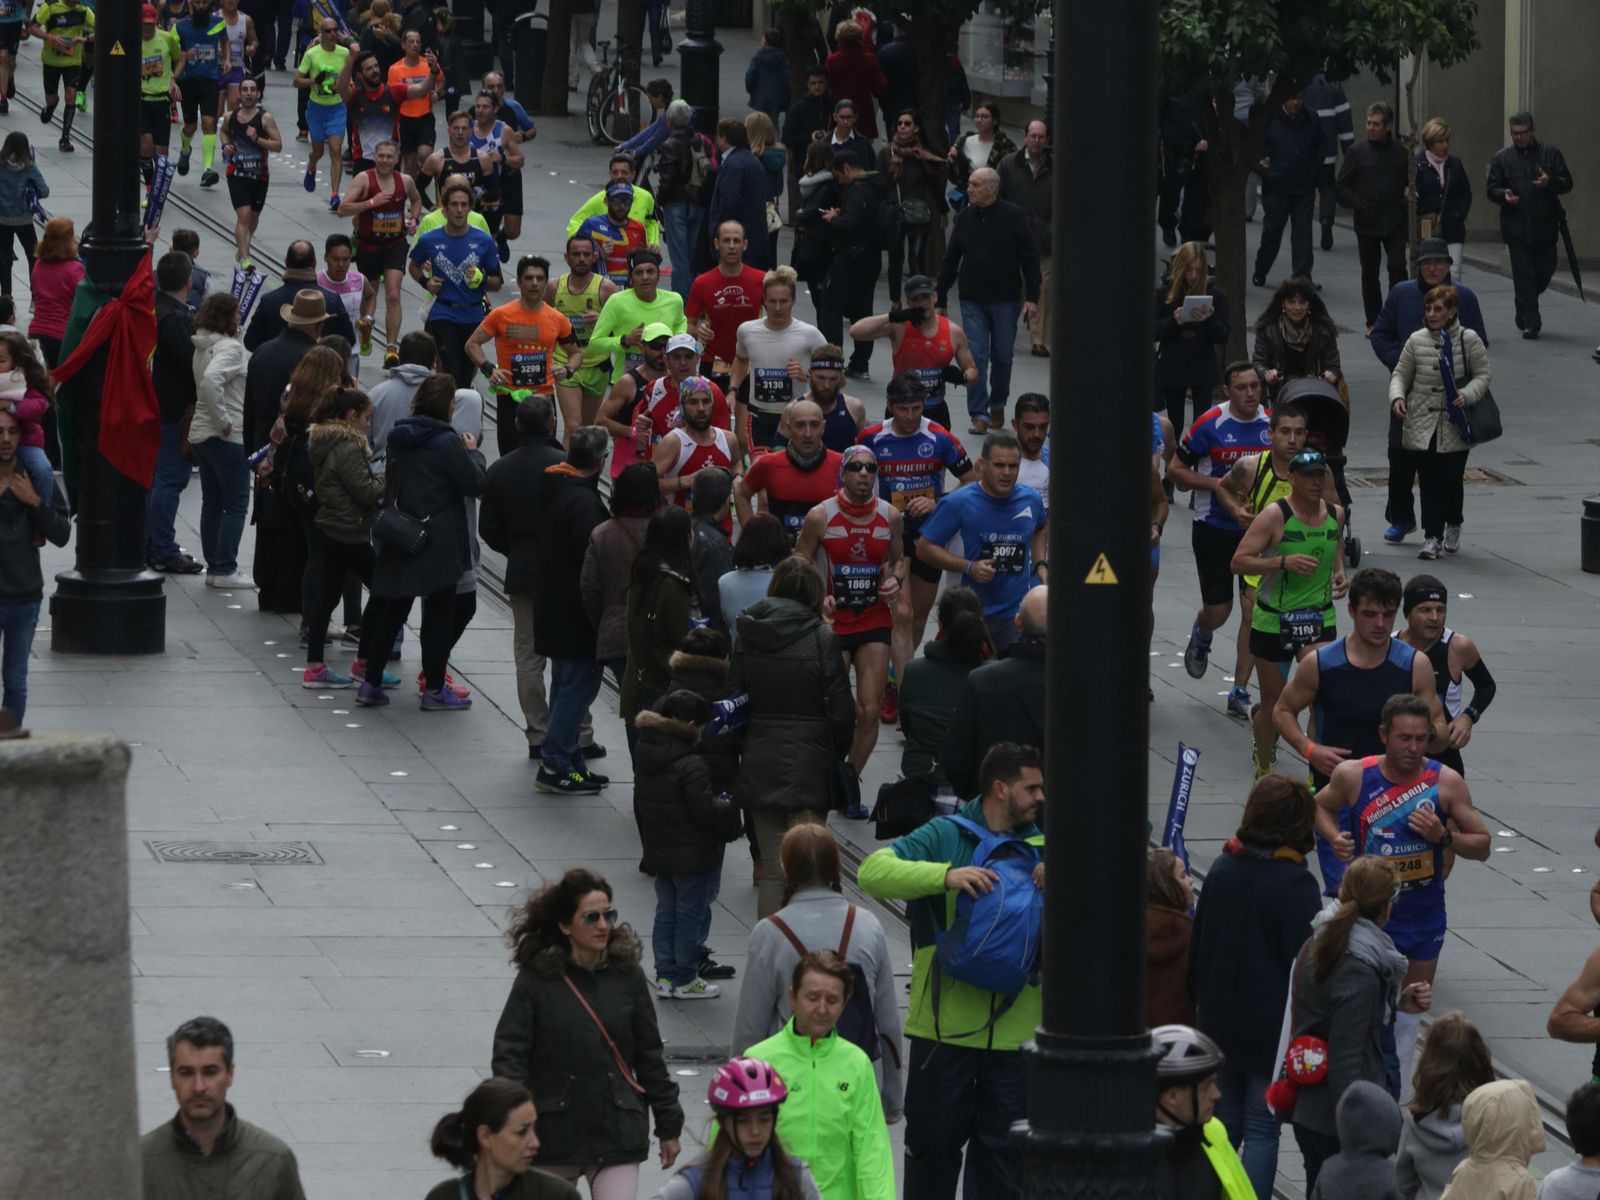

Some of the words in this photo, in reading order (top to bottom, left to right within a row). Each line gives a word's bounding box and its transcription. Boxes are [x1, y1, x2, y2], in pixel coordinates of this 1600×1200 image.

[239, 283, 257, 313] ZURICH
[523, 353, 544, 361] ZURICH
[765, 368, 788, 377] ZURICH
[763, 380, 784, 390] 3130
[994, 546, 1017, 557] 3097
[851, 566, 877, 574] ZURICH
[1175, 766, 1193, 812] ZURICH
[1375, 792, 1390, 808] Club
[1366, 803, 1394, 825] Atletismo
[1394, 842, 1427, 854] ZURICH
[1395, 859, 1422, 873] 248
